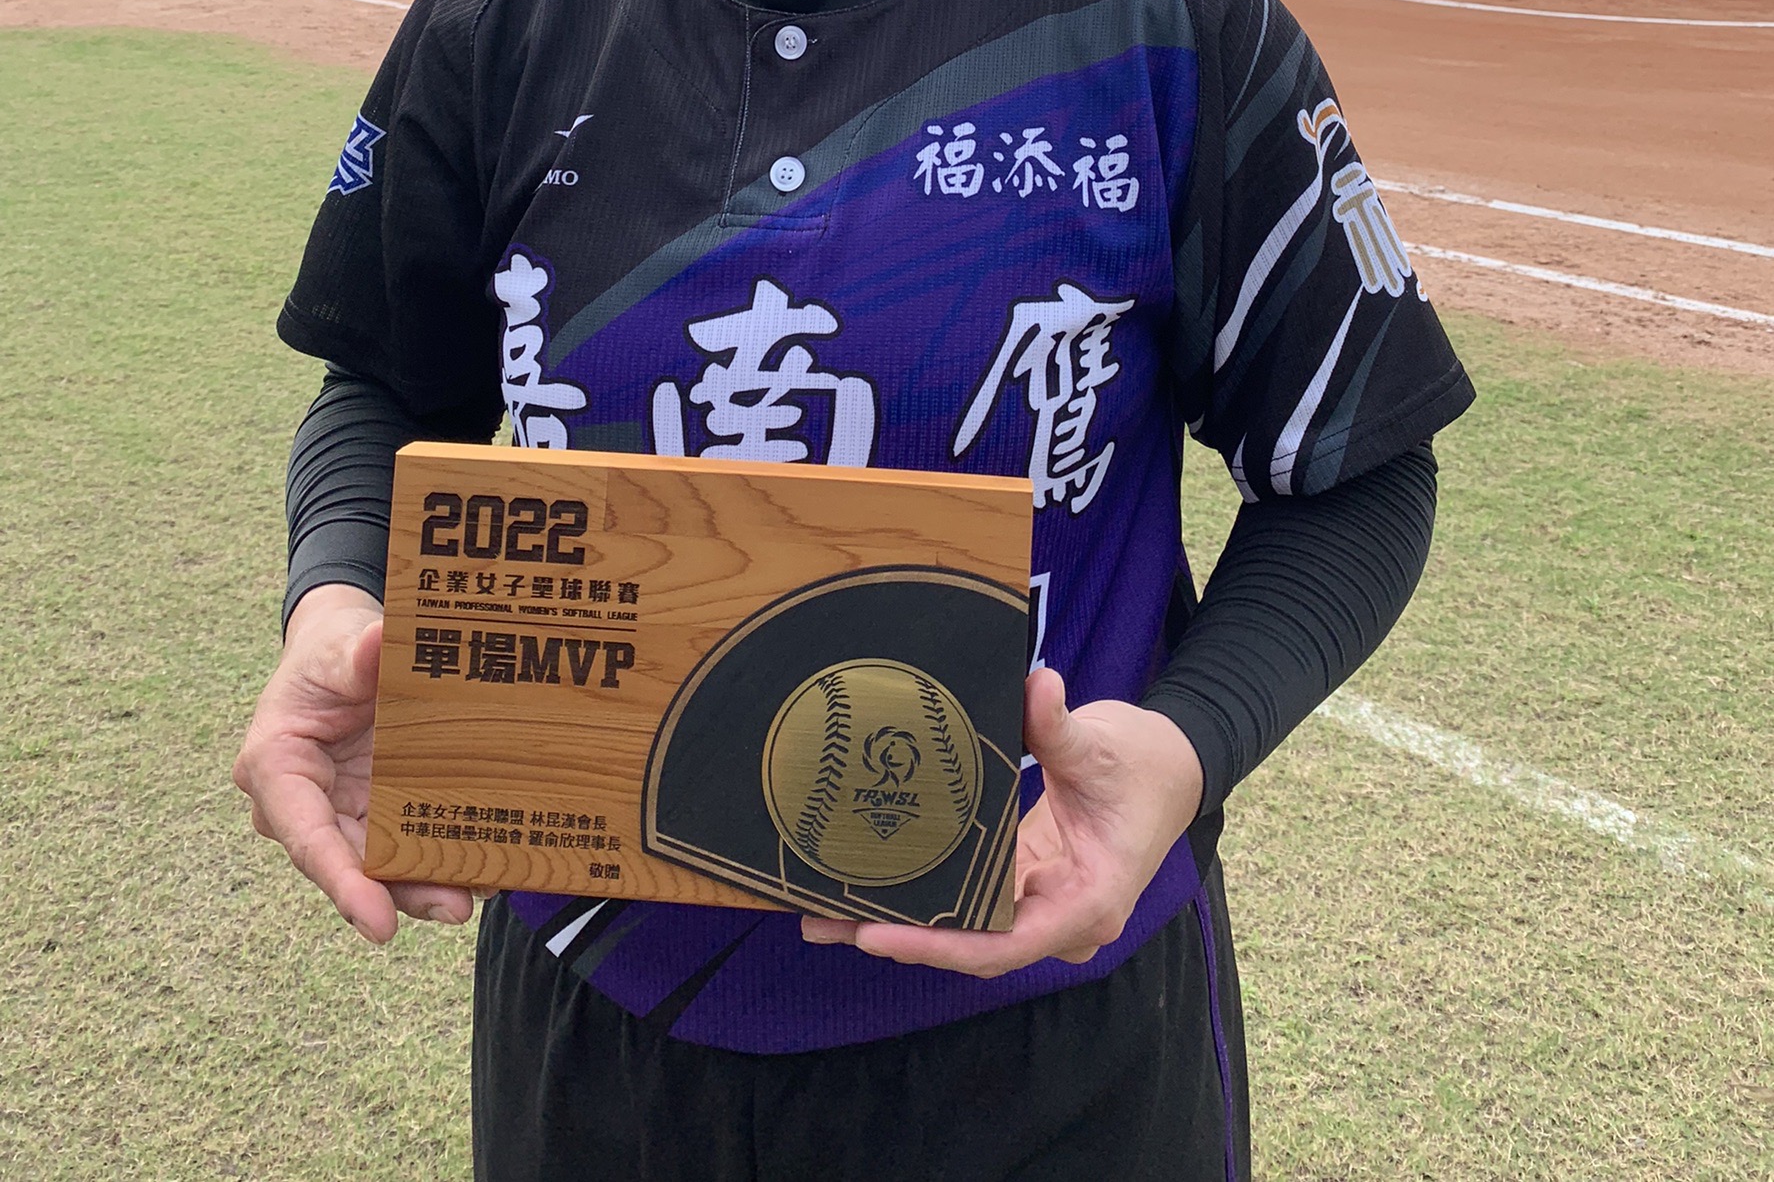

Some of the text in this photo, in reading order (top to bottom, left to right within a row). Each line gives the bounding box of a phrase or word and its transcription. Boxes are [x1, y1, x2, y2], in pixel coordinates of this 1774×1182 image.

[913, 122, 1140, 213] 福添福
[420, 491, 589, 566] 2022
[416, 598, 639, 622] TAIWAN PROFESSIONAL WOMEN'S SOFTBALL LEAGUE
[417, 568, 640, 605] 企業女子壘球聯賽
[412, 627, 636, 689] 單場MVP
[400, 821, 523, 845] 中華民國壘球協會
